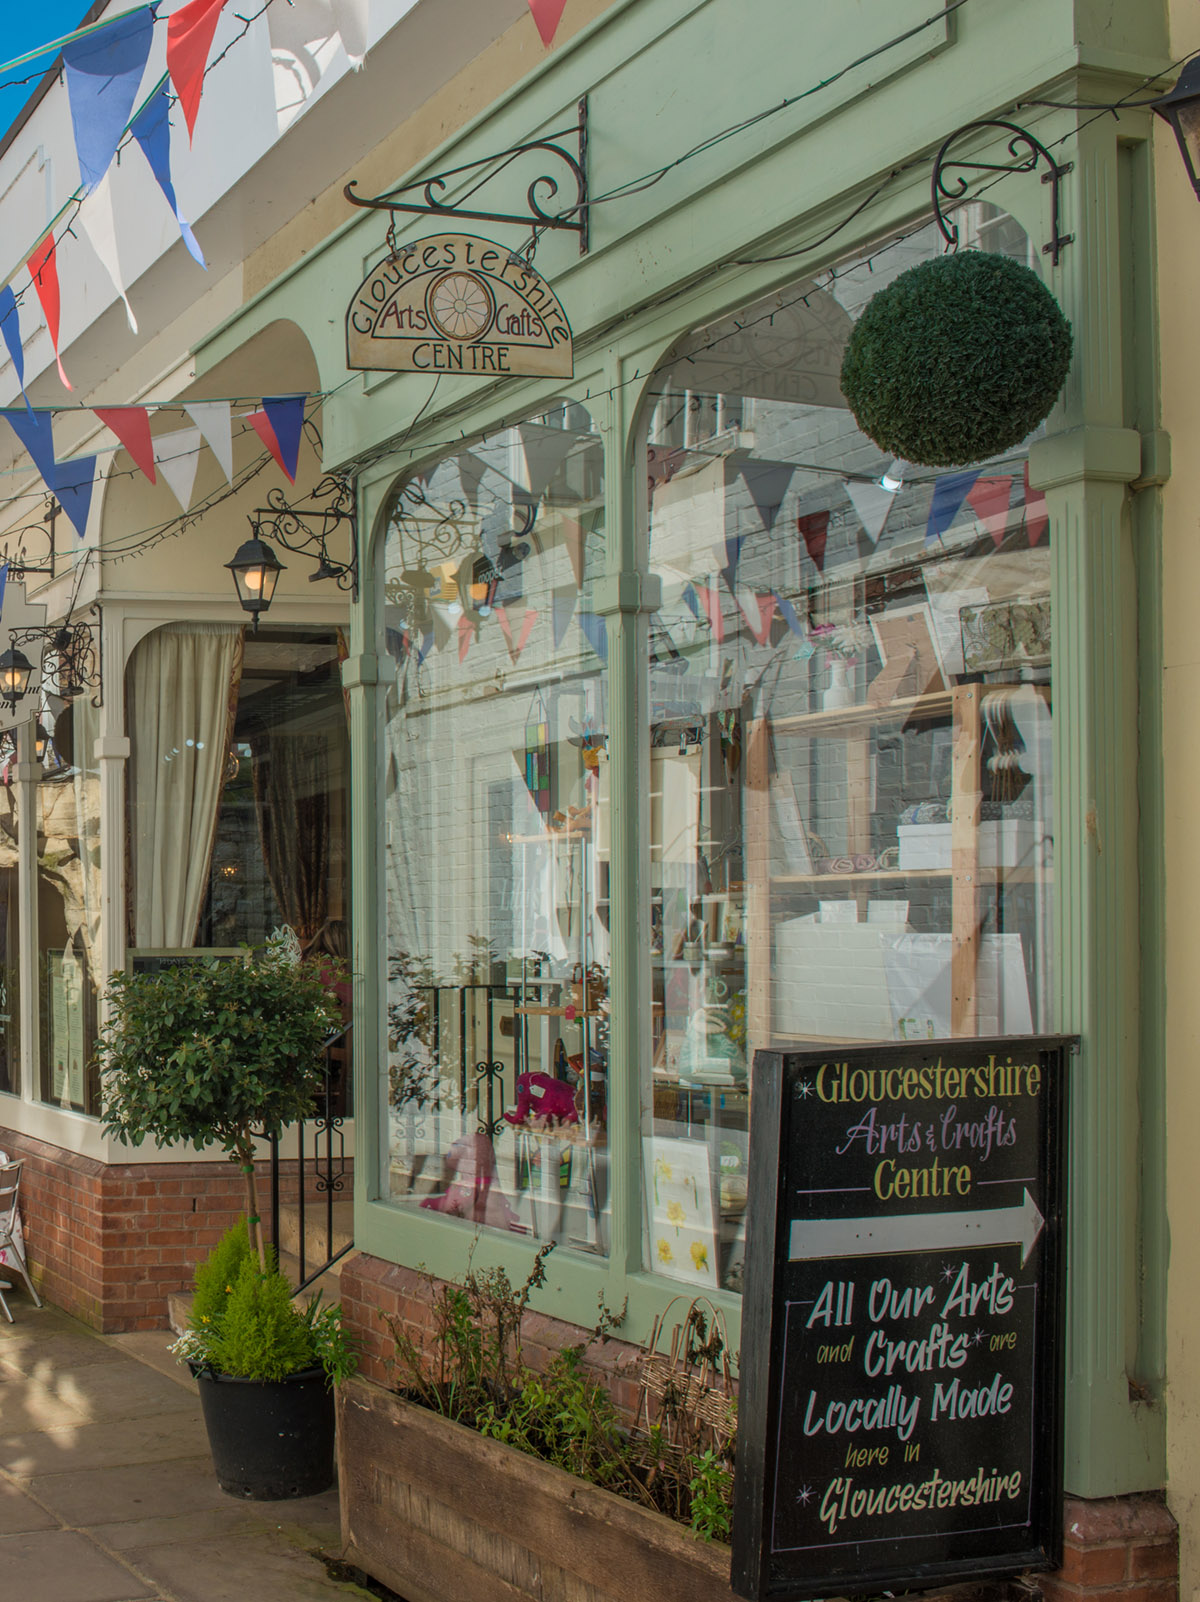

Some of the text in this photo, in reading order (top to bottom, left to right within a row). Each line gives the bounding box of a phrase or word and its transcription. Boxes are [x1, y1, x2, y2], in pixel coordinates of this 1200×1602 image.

[352, 243, 569, 344] Gloucestershire
[380, 300, 542, 337] Arts Crafts
[412, 343, 510, 371] CENTRE
[815, 1054, 1041, 1103] Gloucestershire
[835, 1107, 922, 1155] Arts
[939, 1104, 1017, 1161] Crafts
[874, 1156, 971, 1200] Centre
[805, 1262, 1017, 1328] All Our Arts
[816, 1322, 1017, 1377] and Crafts are
[803, 1372, 1014, 1441] Locally Made
[844, 1440, 921, 1468] here in
[819, 1467, 1022, 1534] Gloucestershire
